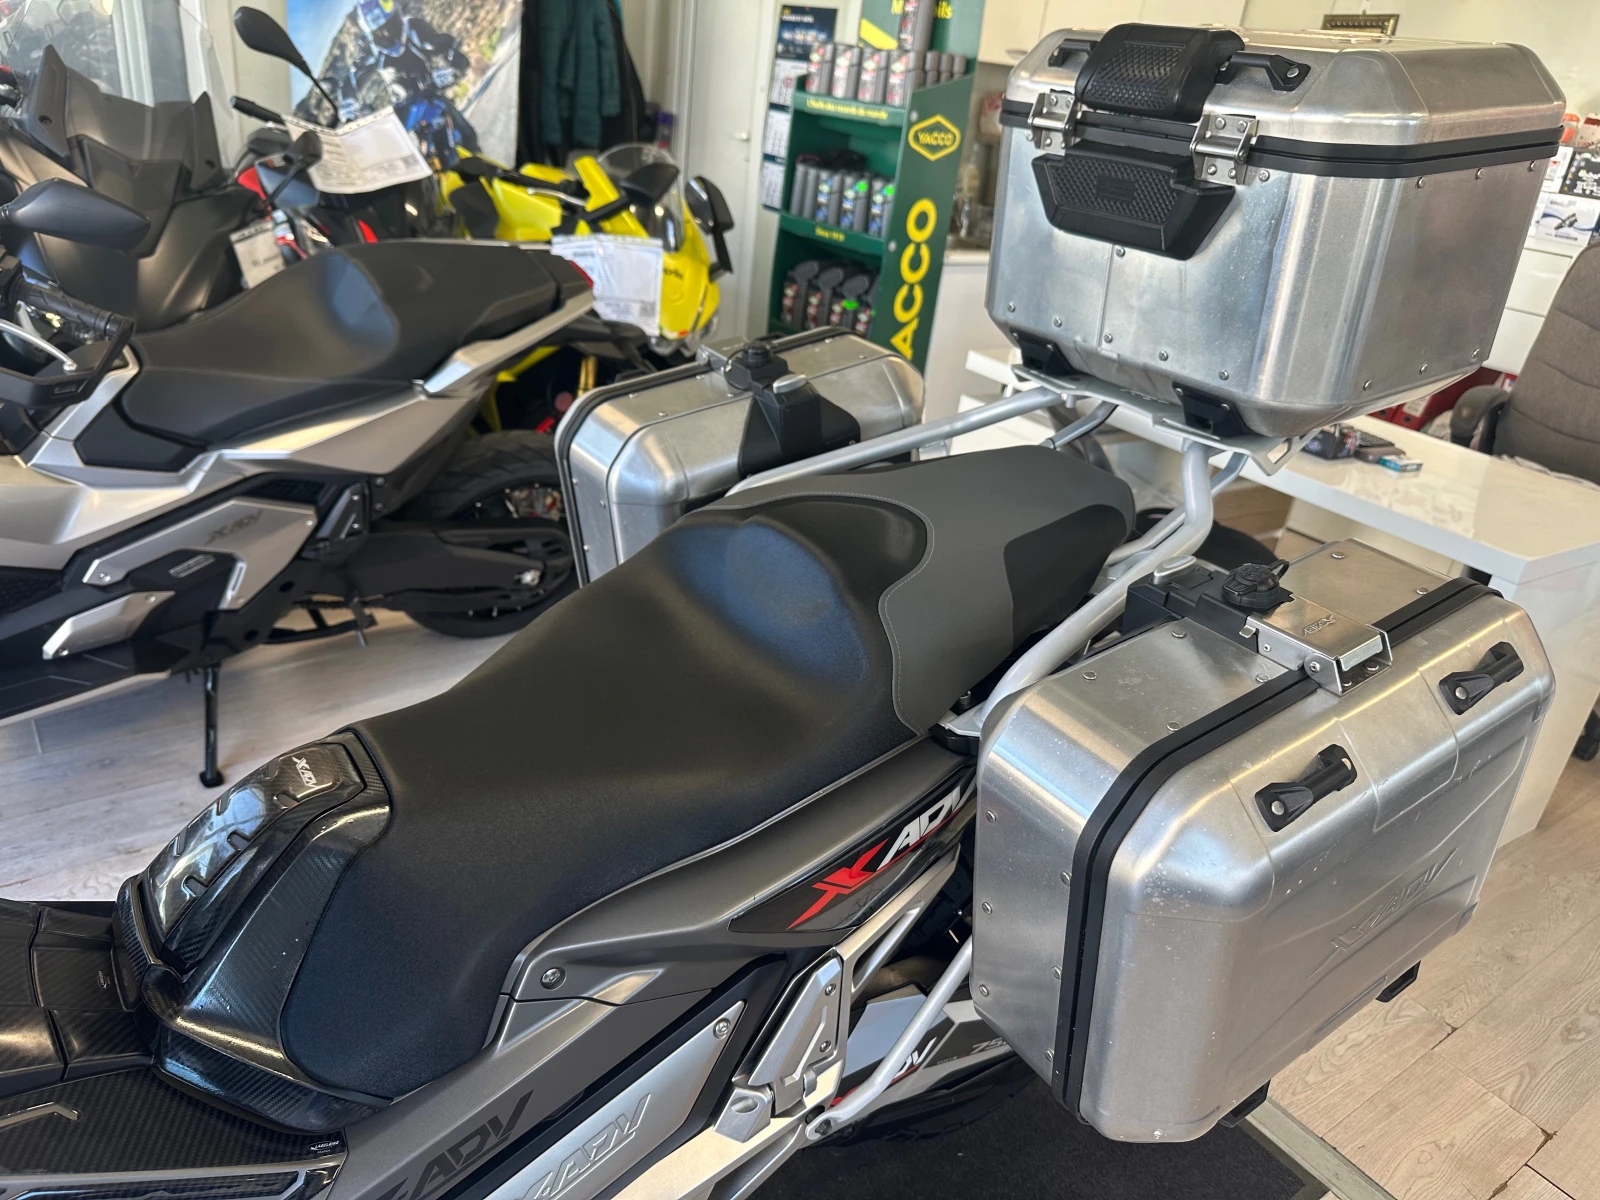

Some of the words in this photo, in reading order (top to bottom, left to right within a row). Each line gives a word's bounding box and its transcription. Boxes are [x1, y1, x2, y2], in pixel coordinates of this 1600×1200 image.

[917, 131, 954, 146] YACCO
[889, 197, 938, 361] ACCO
[969, 1037, 1008, 1054] 75
